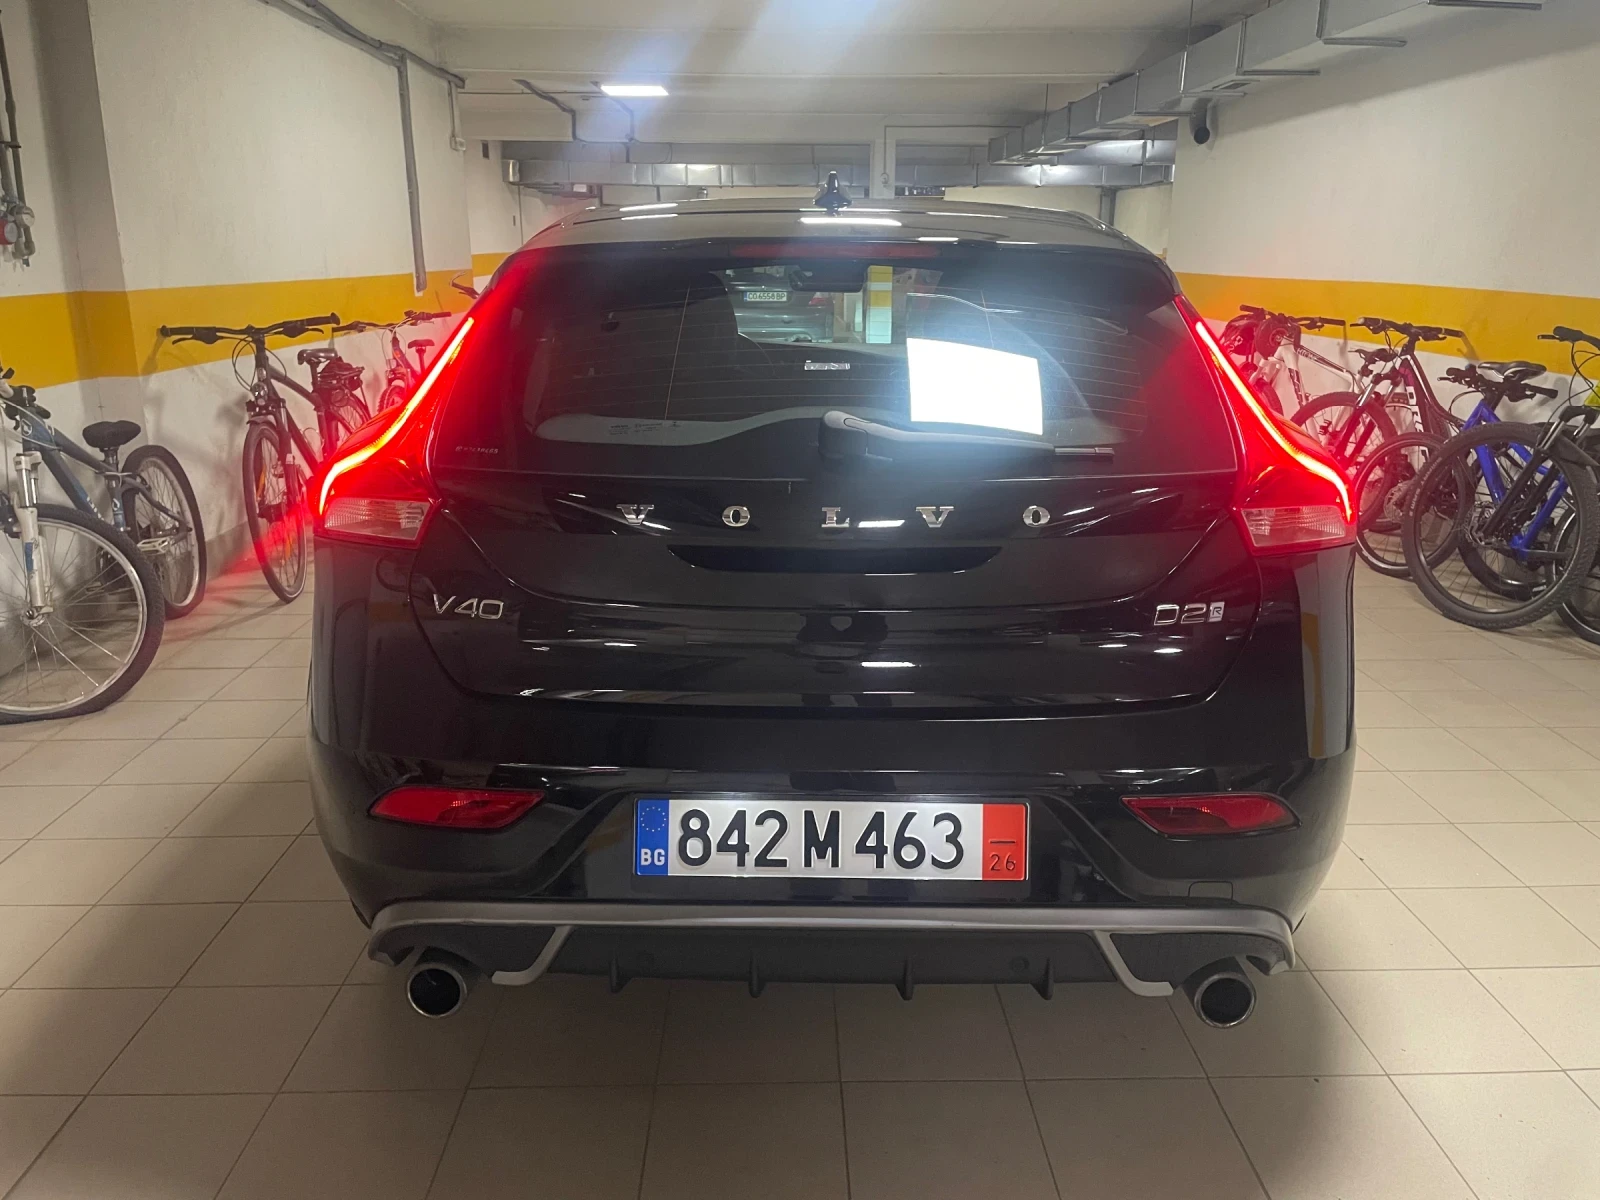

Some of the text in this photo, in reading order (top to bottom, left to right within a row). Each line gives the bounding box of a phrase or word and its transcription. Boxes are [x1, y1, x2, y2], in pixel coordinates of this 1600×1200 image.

[616, 503, 1050, 528] VOLVO
[433, 594, 504, 619] V40
[678, 809, 964, 870] 842 M 463
[640, 848, 665, 866] BG
[989, 852, 1017, 872] 26
